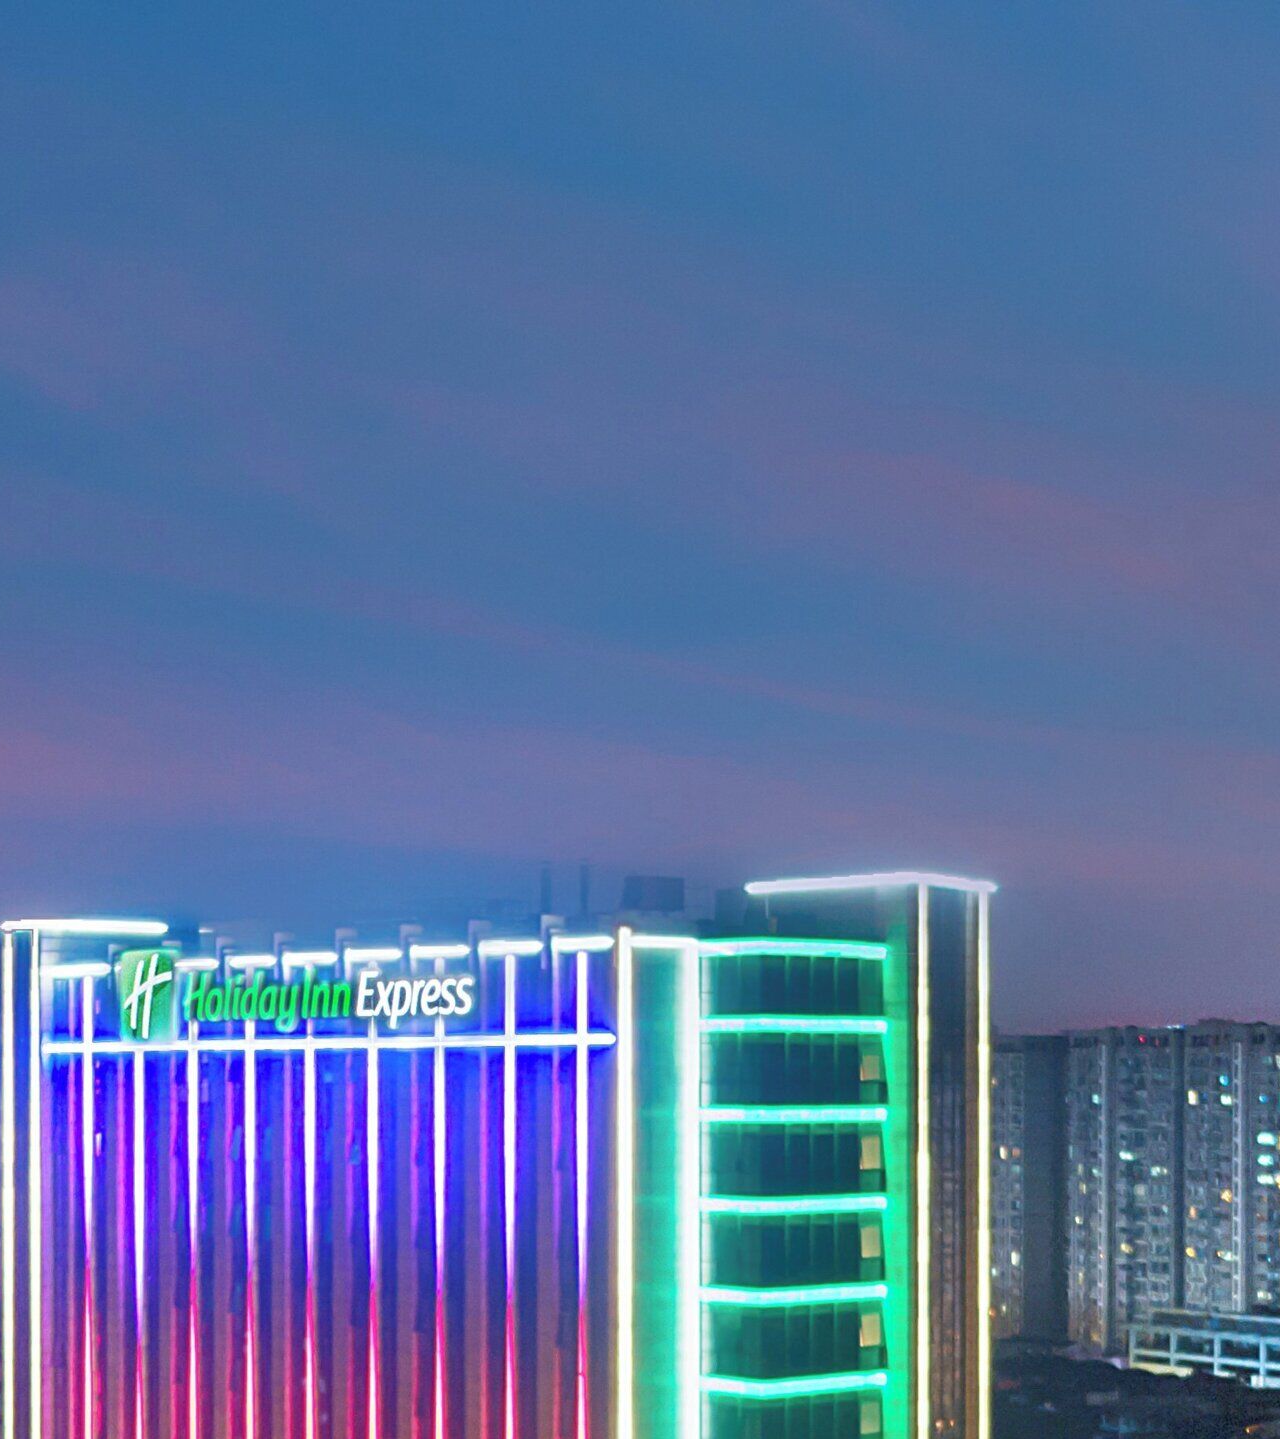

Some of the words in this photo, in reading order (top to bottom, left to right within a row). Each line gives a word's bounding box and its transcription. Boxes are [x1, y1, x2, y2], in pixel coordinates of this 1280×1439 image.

[184, 970, 299, 1033] Holiday
[300, 967, 351, 1020] Inn
[356, 969, 474, 1030] Express
